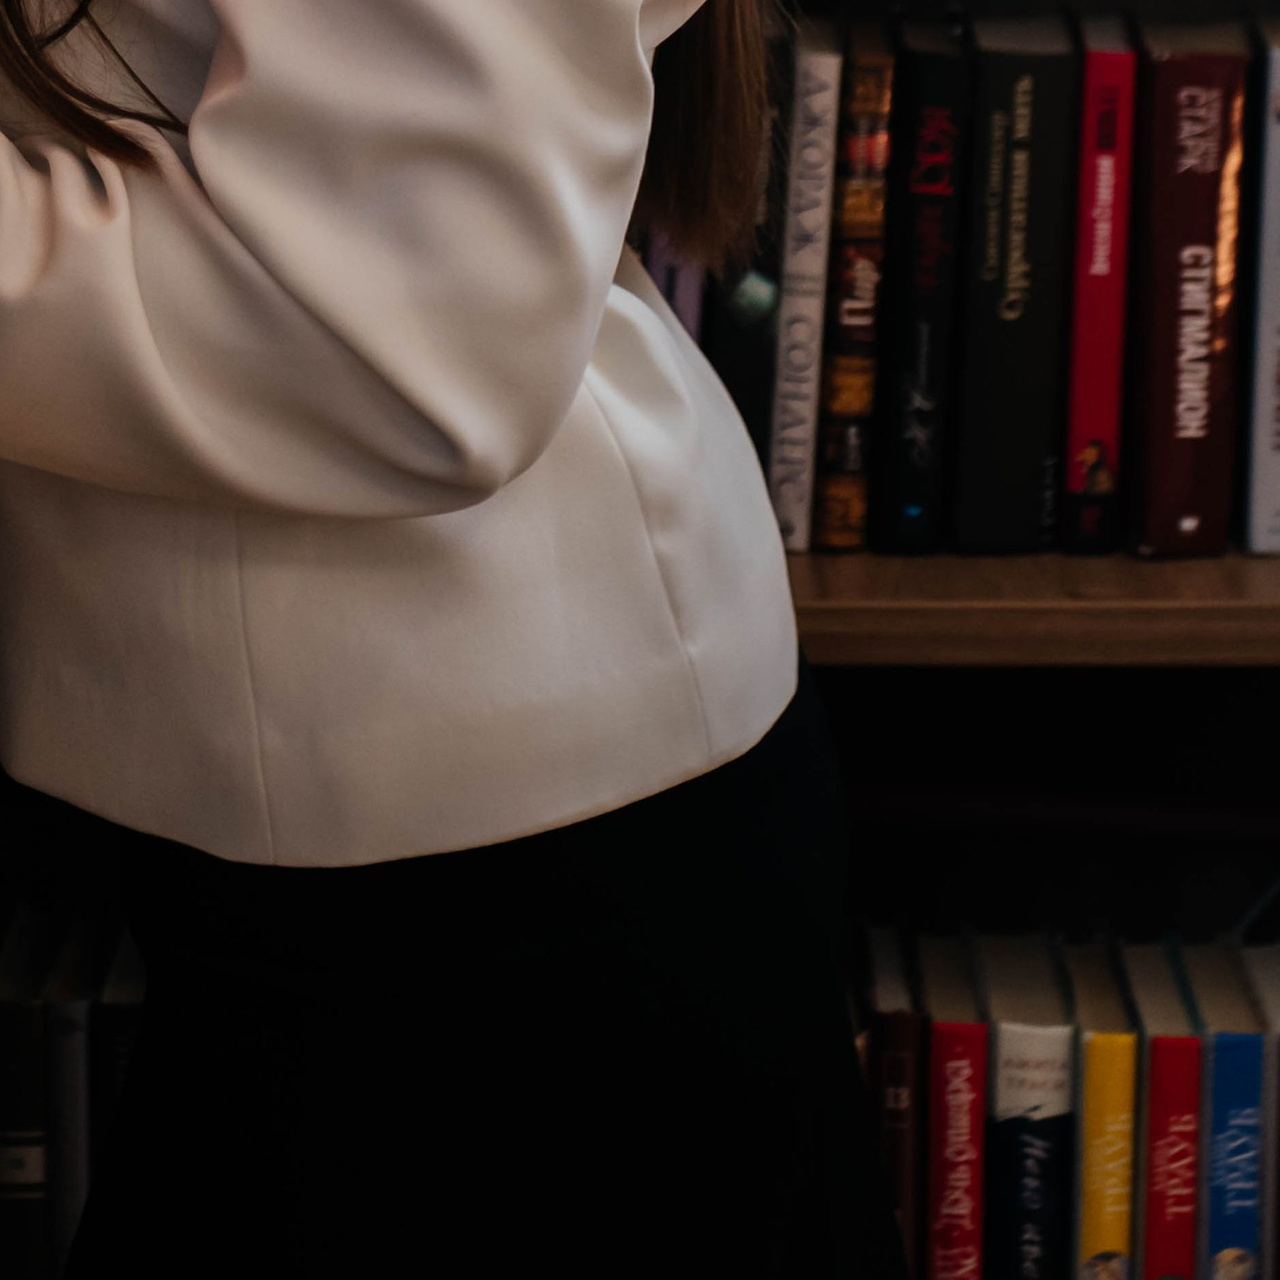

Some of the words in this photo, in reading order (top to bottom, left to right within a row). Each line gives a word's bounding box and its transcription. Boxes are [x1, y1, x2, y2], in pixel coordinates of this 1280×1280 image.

[1175, 244, 1213, 439] СТИГМАЛИОН
[1165, 1113, 1197, 1221] ТРАУБ
[1224, 1107, 1260, 1216] ТРАУБ
